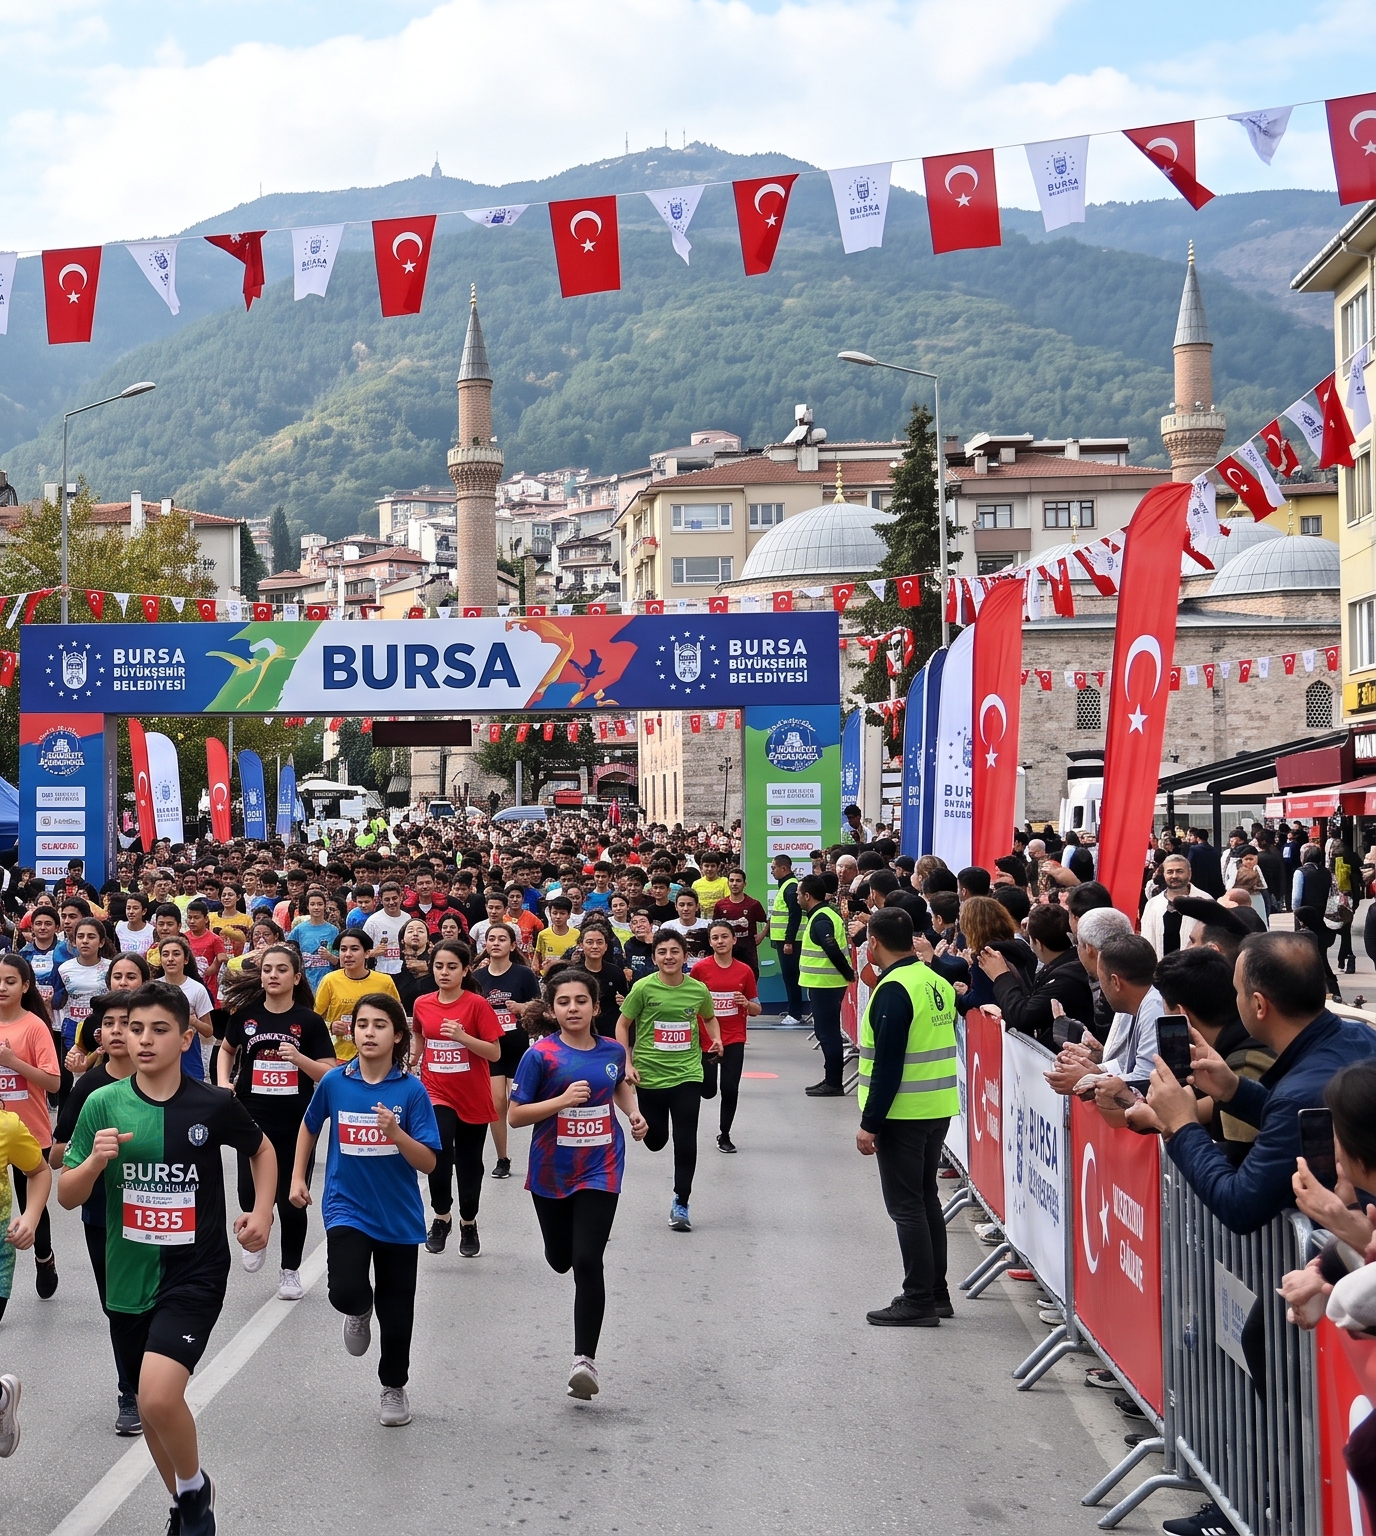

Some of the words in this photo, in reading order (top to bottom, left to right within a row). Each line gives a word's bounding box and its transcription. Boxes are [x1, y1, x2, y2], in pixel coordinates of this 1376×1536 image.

[113, 648, 186, 664] BURSA
[728, 639, 808, 656] BURSA
[323, 642, 521, 690] BURSA
[661, 1031, 686, 1042] 2200
[1029, 1106, 1059, 1175] BURSA
[122, 1162, 200, 1183] BURSA
[134, 1209, 183, 1230] 1335
